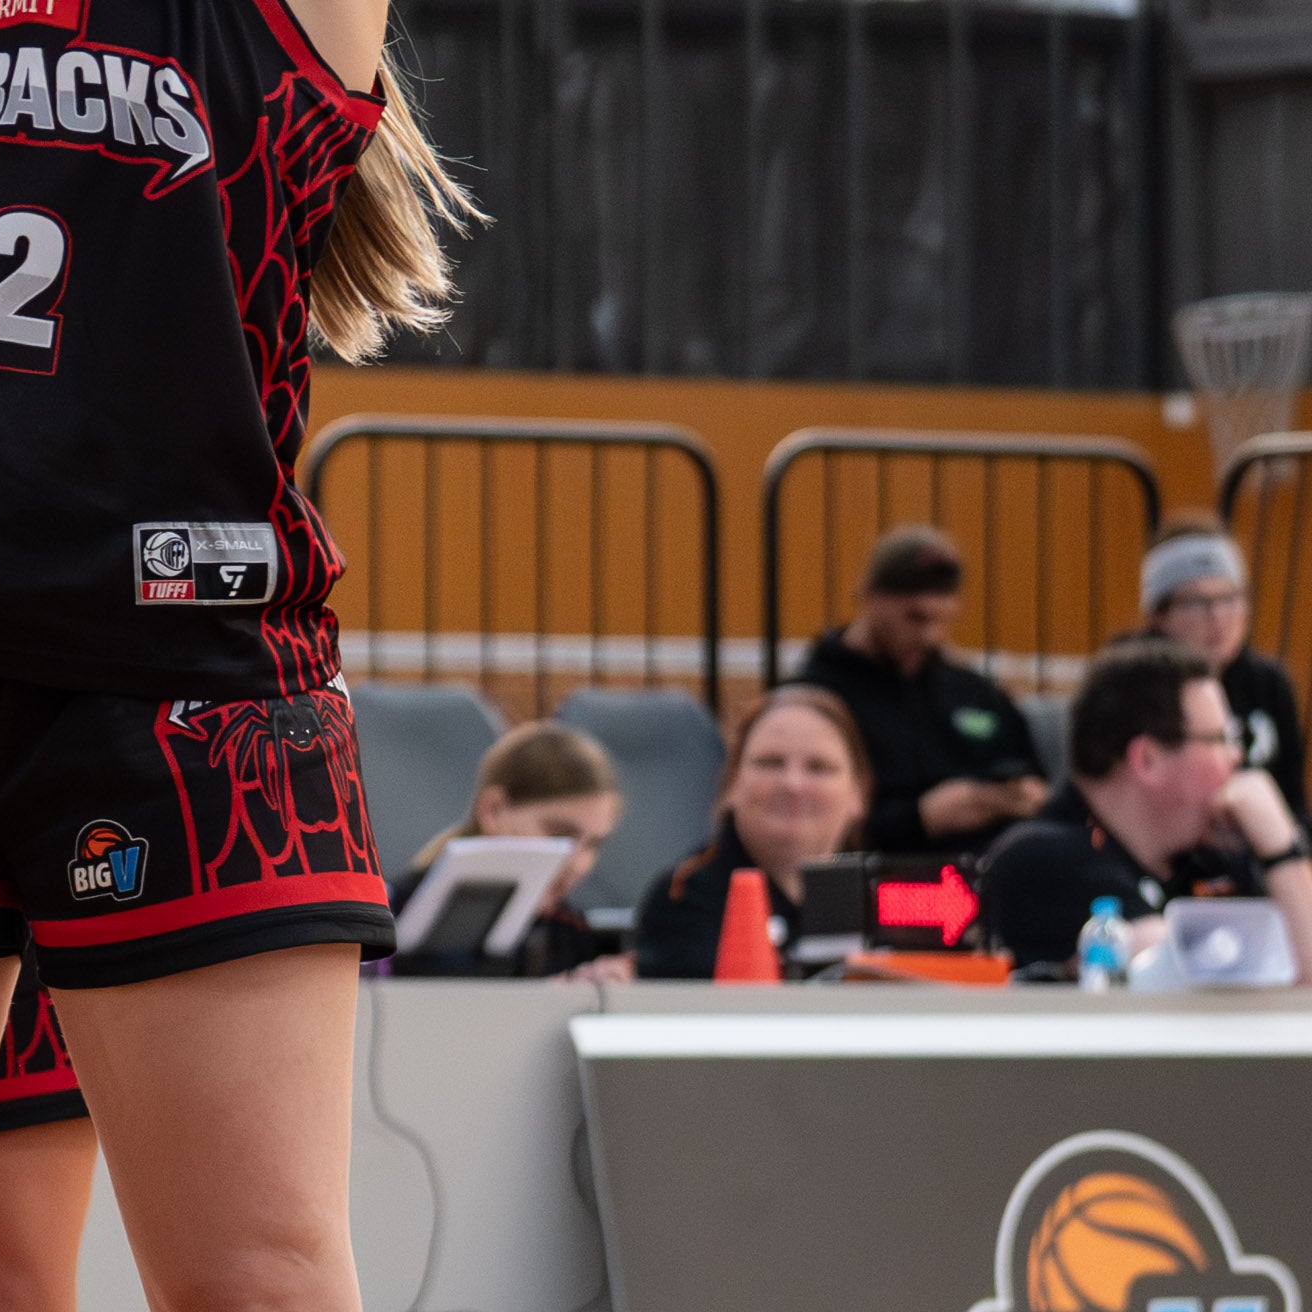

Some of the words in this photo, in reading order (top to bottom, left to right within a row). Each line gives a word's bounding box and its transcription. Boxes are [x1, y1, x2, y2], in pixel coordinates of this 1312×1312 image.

[196, 540, 264, 552] X-SMALL
[148, 582, 189, 599] TUFF!
[74, 862, 113, 893] BIG
